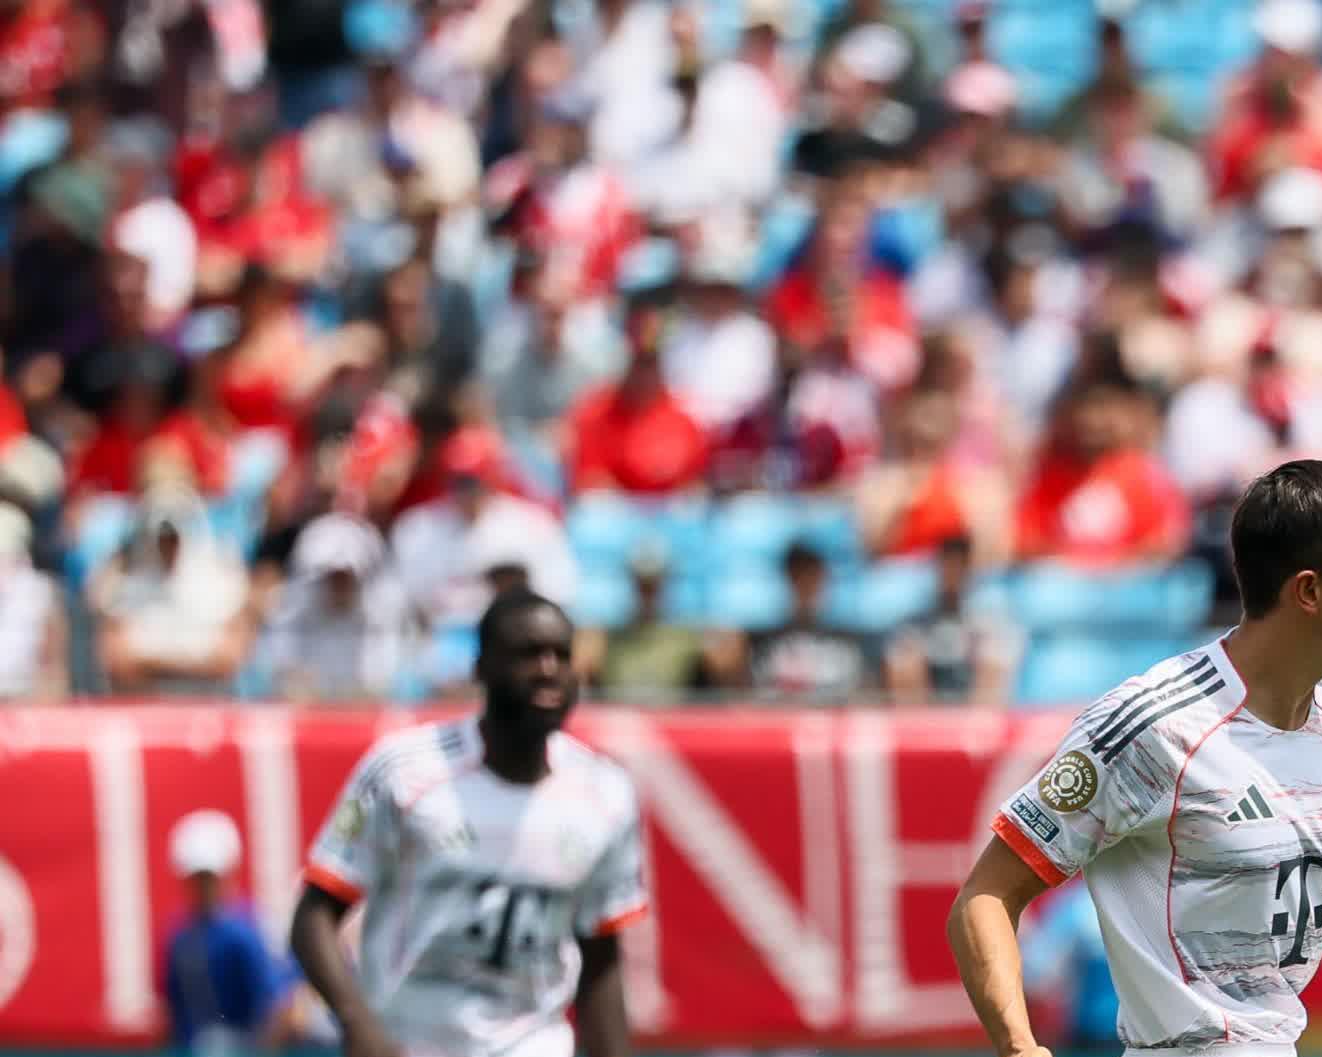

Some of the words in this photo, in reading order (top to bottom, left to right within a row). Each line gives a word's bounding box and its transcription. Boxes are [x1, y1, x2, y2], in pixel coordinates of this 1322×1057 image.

[1044, 759, 1059, 782] CLUB
[1060, 755, 1085, 768] WORLD
[1083, 767, 1093, 785] CUP
[1042, 785, 1062, 807] FIFA
